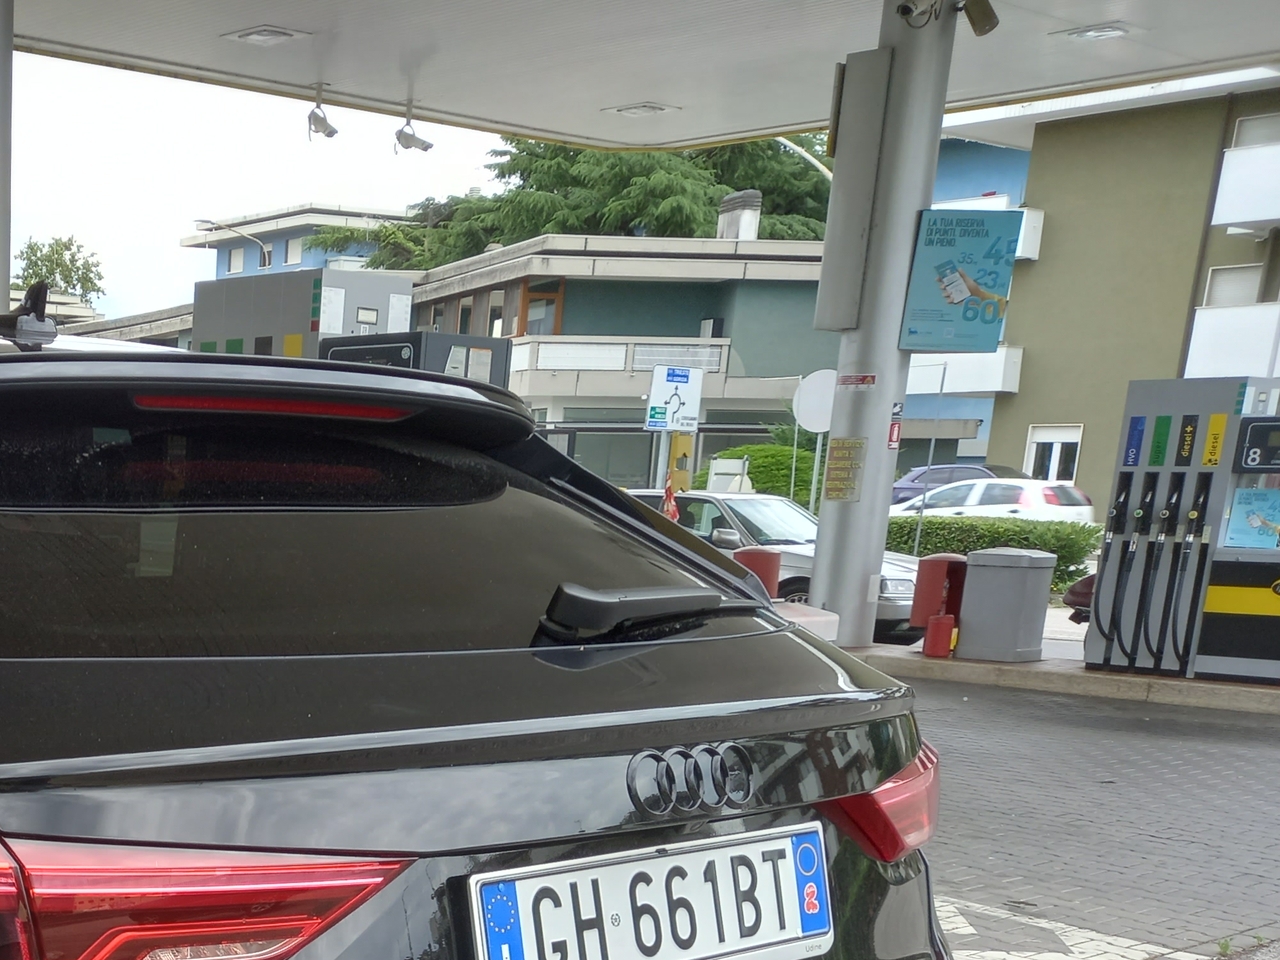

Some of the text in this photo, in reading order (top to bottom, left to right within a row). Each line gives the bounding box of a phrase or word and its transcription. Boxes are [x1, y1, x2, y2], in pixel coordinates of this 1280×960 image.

[927, 217, 985, 228] LA TUA RISERVA
[926, 227, 934, 237] DI
[959, 228, 989, 238] DIVENTA
[924, 237, 934, 247] UN
[1209, 433, 1220, 457] diesel
[1247, 447, 1261, 465] 8
[629, 848, 786, 957] 661BT
